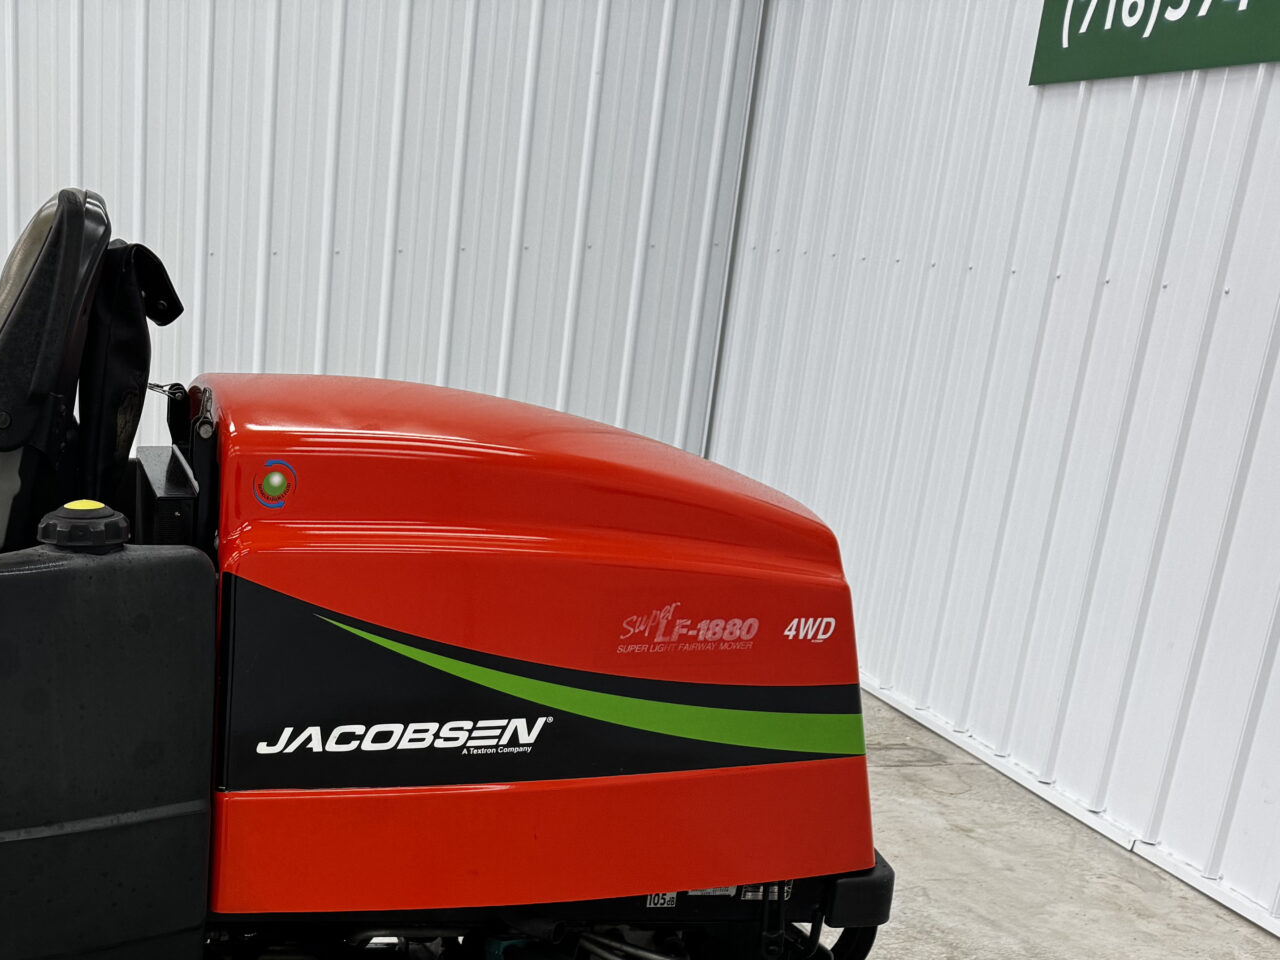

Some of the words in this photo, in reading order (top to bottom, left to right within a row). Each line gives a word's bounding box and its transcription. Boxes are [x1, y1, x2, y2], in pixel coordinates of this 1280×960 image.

[783, 617, 837, 640] 4WD
[616, 644, 649, 653] SUPER
[650, 643, 677, 653] LIGHT
[678, 643, 716, 652] FAIRWAY
[719, 641, 754, 650] MOWER
[469, 747, 497, 755] Textron
[498, 746, 533, 754] Company
[648, 893, 667, 906] 105
